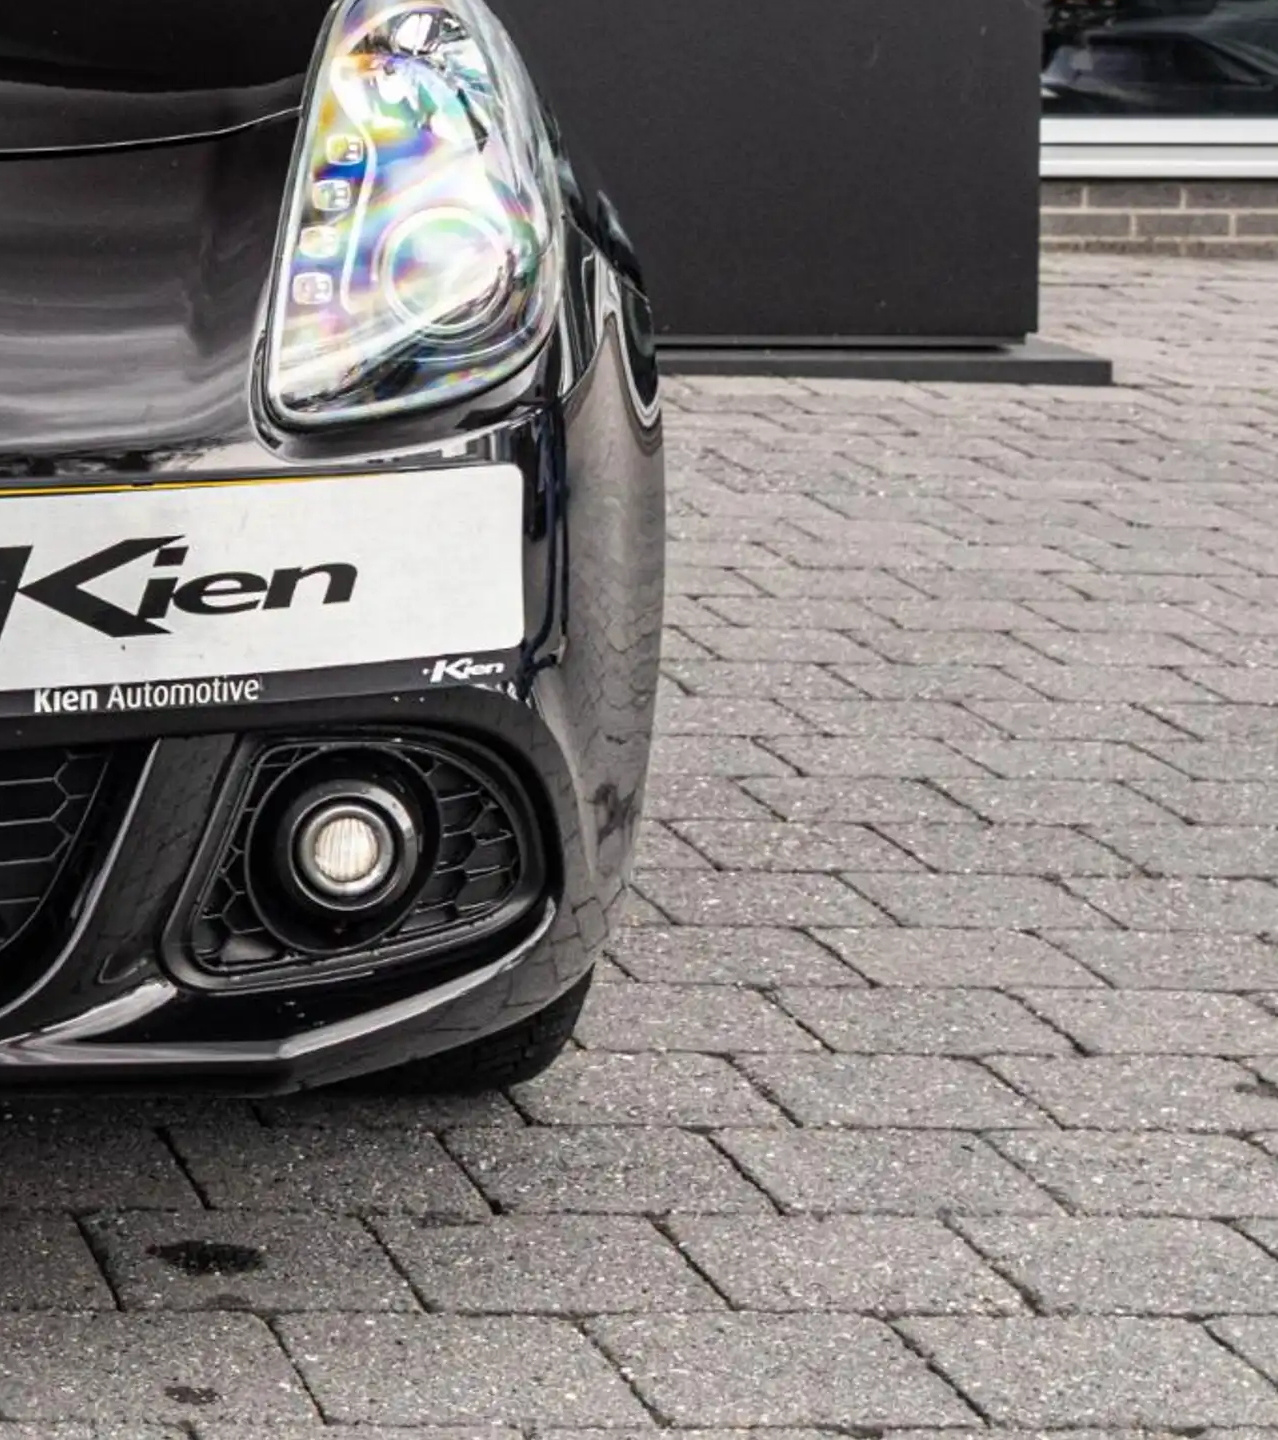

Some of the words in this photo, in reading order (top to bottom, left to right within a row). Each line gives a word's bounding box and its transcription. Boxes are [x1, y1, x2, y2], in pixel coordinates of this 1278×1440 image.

[429, 657, 505, 683] Kien
[34, 687, 99, 713] Kien
[106, 675, 260, 711] Automotive
